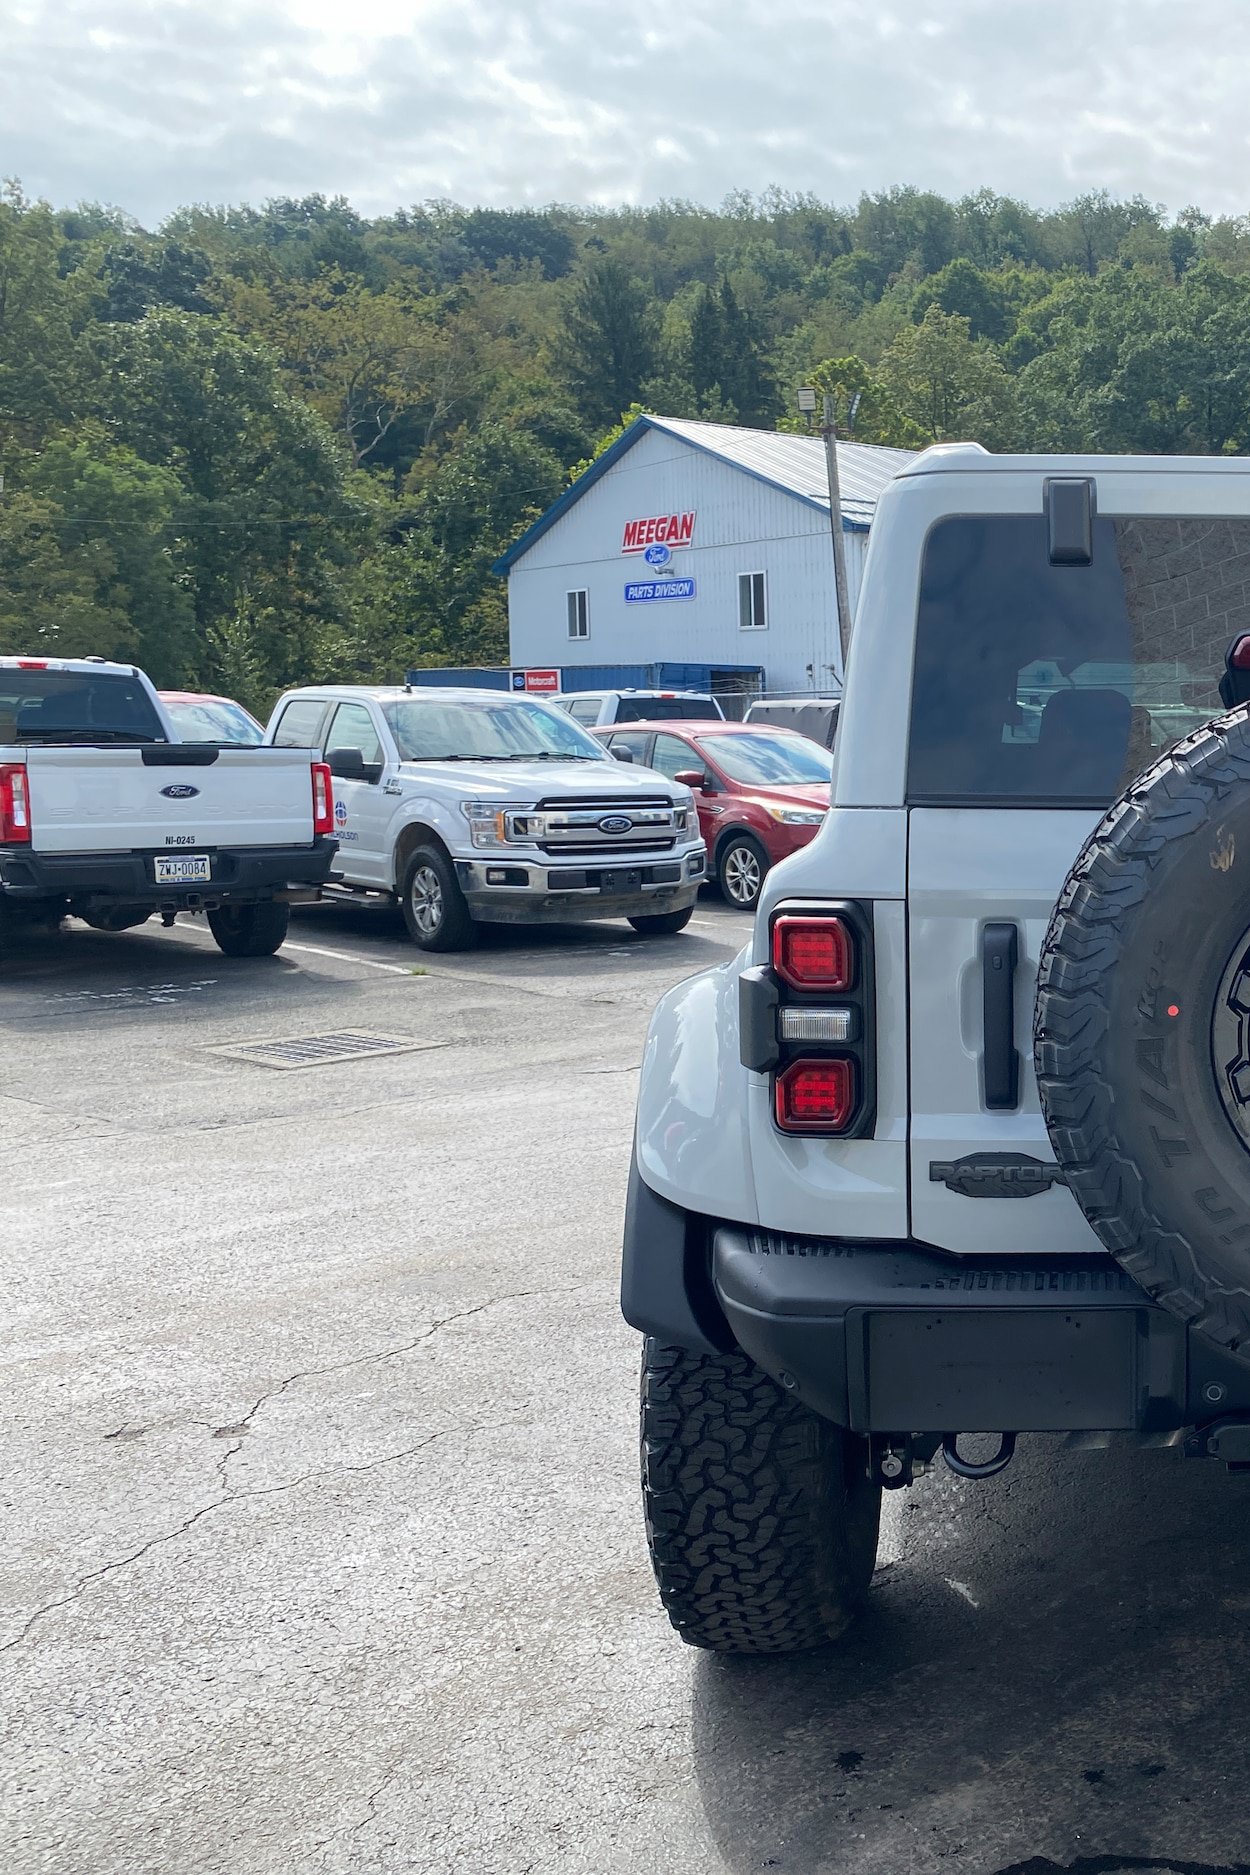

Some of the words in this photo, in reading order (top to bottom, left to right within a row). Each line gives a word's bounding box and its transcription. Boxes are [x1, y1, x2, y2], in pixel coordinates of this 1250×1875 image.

[622, 513, 695, 548] MEEGAN
[647, 547, 667, 563] Ford
[627, 585, 653, 600] PARTS
[654, 582, 692, 597] DIVISION
[169, 785, 192, 797] Ford
[49, 805, 193, 818] SUPER
[203, 803, 299, 815] DUTY
[608, 820, 626, 829] Ford
[165, 836, 196, 845] NI-0245
